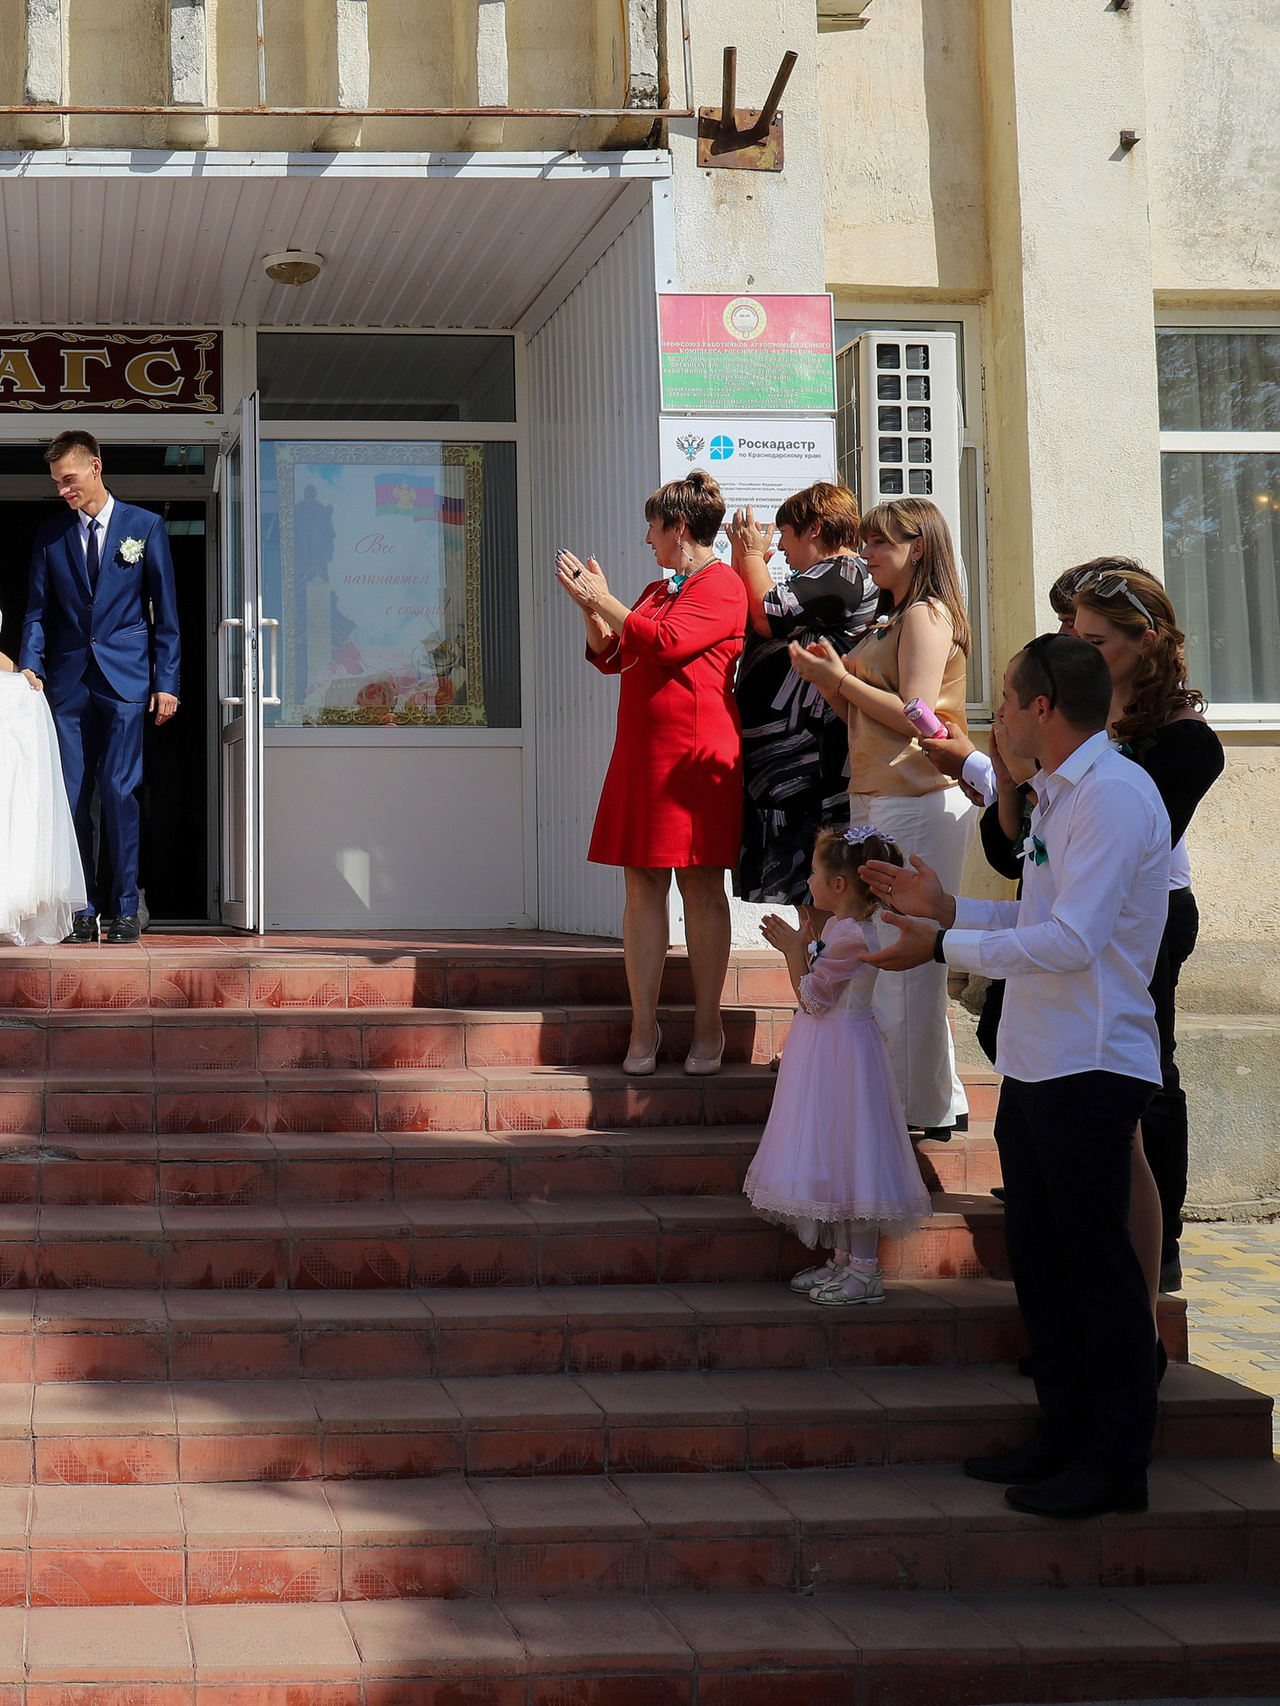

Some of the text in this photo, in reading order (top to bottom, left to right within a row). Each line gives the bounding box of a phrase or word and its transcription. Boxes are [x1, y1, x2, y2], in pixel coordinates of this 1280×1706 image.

[738, 438, 815, 452] Роскадастр
[355, 533, 396, 554] Все
[344, 574, 429, 584] начинается
[386, 598, 451, 616] с семьи!
